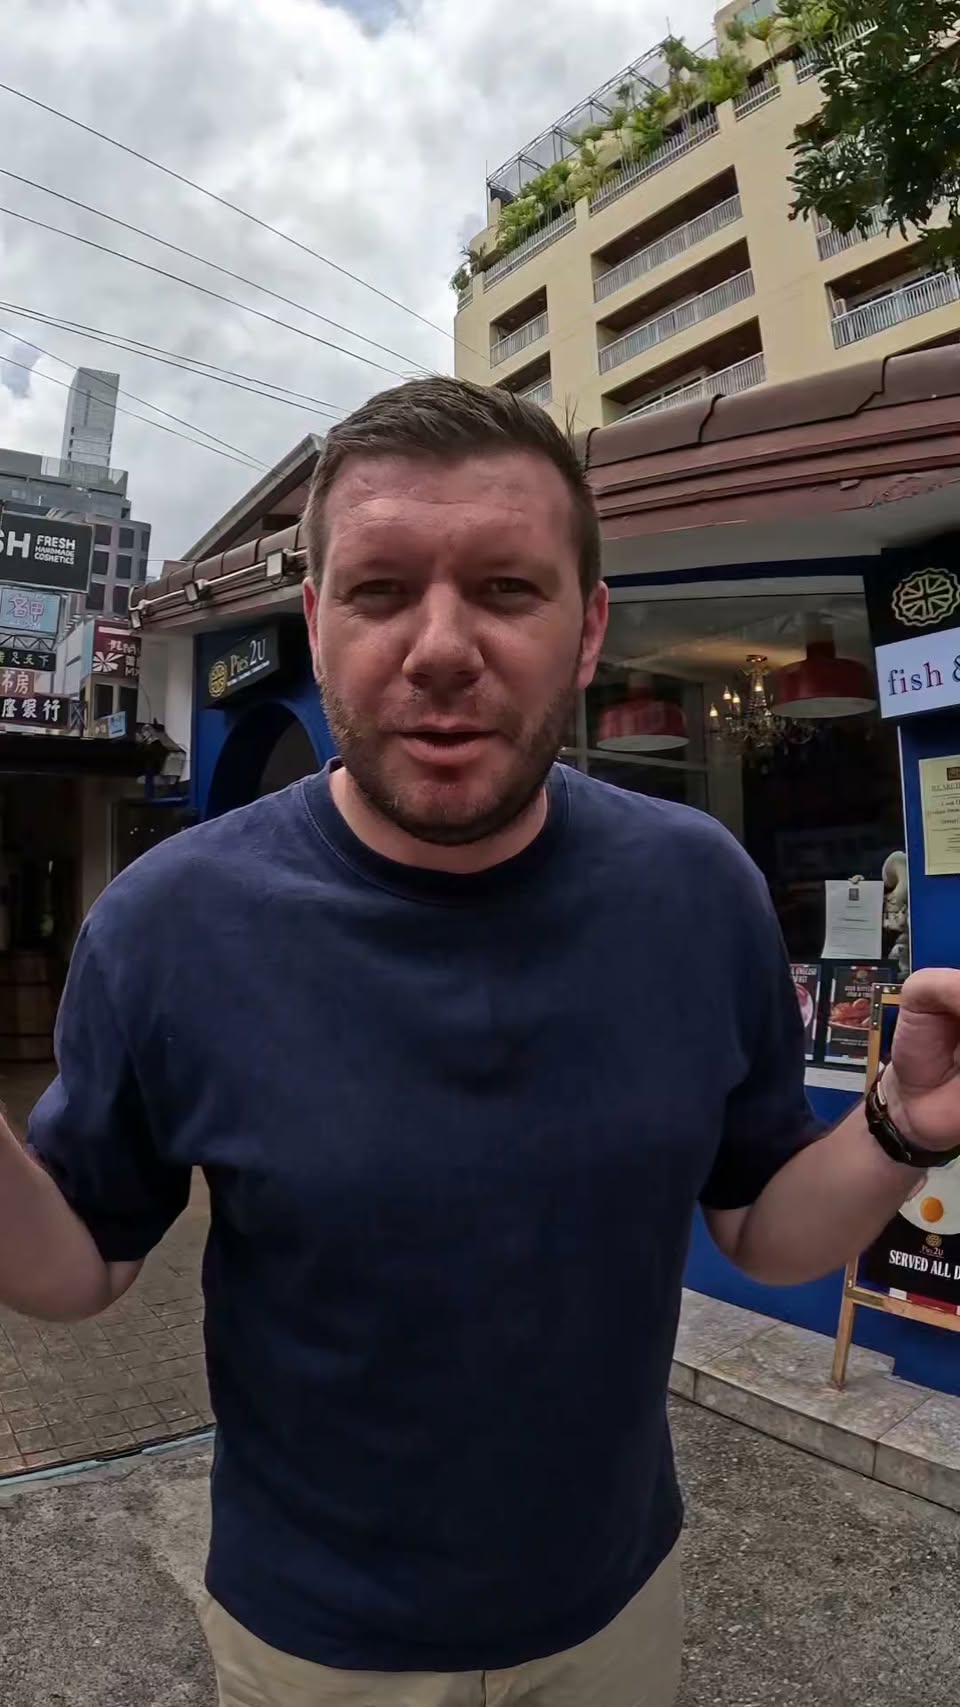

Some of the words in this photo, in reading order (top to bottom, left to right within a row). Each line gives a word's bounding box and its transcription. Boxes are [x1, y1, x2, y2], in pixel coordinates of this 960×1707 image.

[0, 528, 31, 559] H
[35, 545, 75, 557] HANDMADE
[36, 534, 76, 550] FRESH
[34, 552, 75, 565] COSMETICS
[249, 638, 266, 666] 2U
[888, 661, 944, 696] fish
[889, 1249, 929, 1272] SERVED
[930, 1260, 951, 1278] ALL
